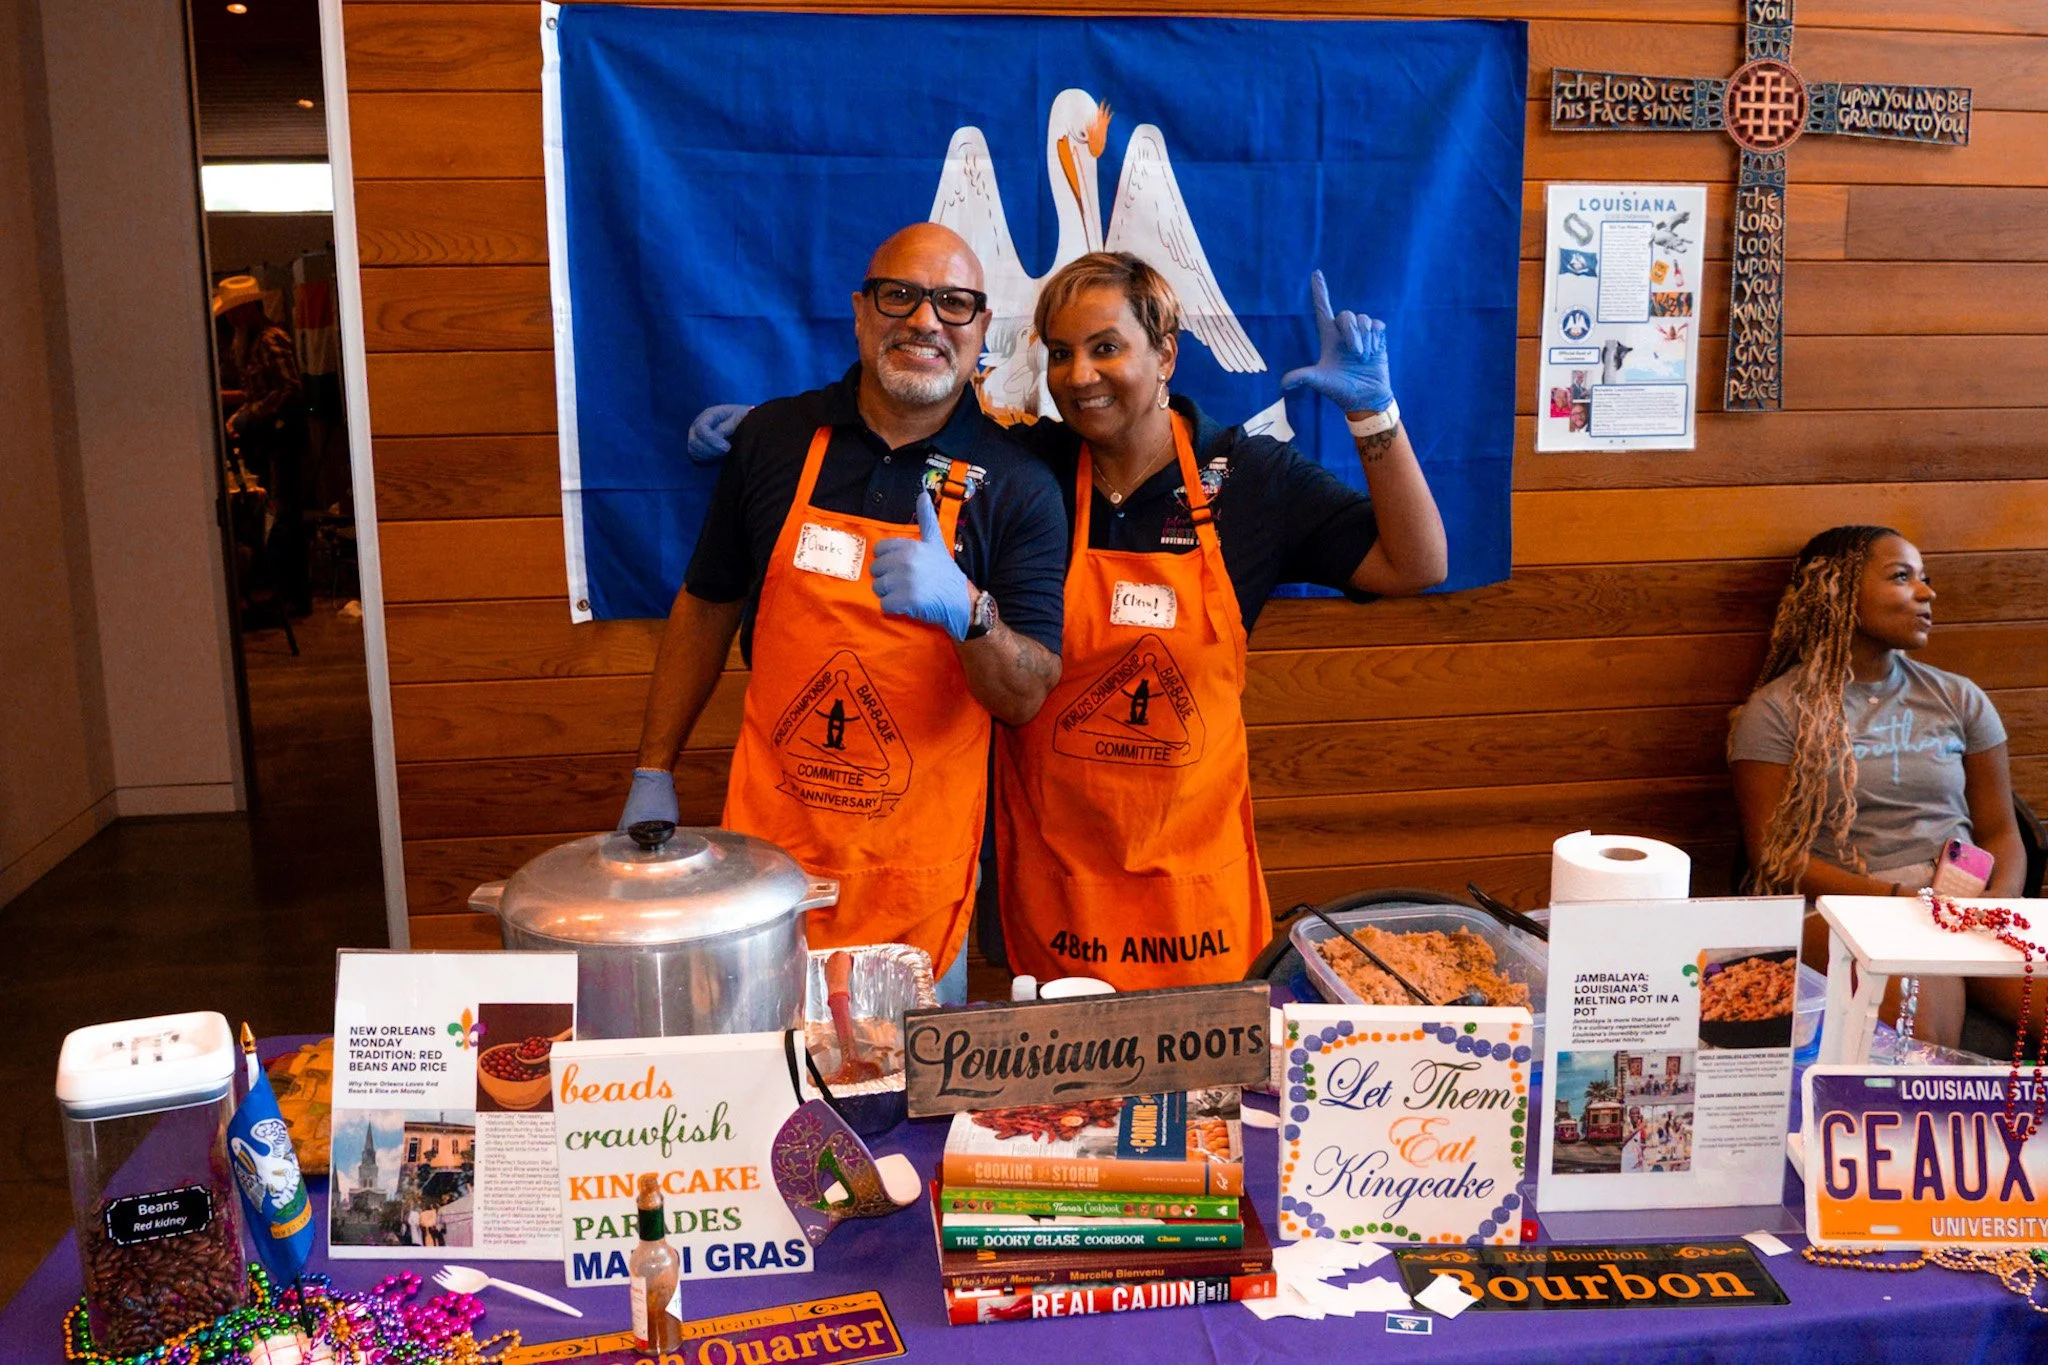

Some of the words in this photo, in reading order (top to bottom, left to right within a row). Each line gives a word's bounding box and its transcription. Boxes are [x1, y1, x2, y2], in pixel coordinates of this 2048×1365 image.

[1579, 198, 1677, 212] LOUISIANA
[790, 671, 832, 722] CHAMPIONSHIP
[1060, 697, 1093, 732] WORLD'S
[1090, 653, 1140, 706] CHAMPIONSHIP
[1160, 666, 1195, 721] BAR-B-QUE
[856, 684, 896, 745] BAR-B-QUE
[1096, 741, 1171, 761] COMMITTEE
[797, 763, 865, 787] COMMITTEE
[800, 788, 878, 808] ANNIVERSARY
[1050, 930, 1107, 962] 48th
[1121, 929, 1230, 964] ANNUAL
[1575, 973, 1649, 983] JAMBALAYA:
[1575, 984, 1649, 994] LOUISIANA'S
[1574, 995, 1626, 1005] MELTING
[1630, 995, 1653, 1004] POT
[1656, 995, 1668, 1003] IN
[1671, 994, 1680, 1003] A
[1574, 1007, 1597, 1016] POT
[350, 1026, 377, 1036] NEW
[381, 1026, 436, 1036] ORLEANS
[349, 1038, 402, 1048] MONDAY
[349, 1050, 416, 1060] TRADITION:
[419, 1050, 443, 1060] RED
[909, 1026, 1145, 1097] Louisiana
[1156, 1024, 1265, 1064] ROOTS
[349, 1062, 388, 1072] BEANS
[391, 1062, 417, 1072] AND
[420, 1062, 447, 1072] RICE
[560, 1063, 674, 1105] beads
[1319, 1057, 1393, 1111] Let
[1403, 1058, 1516, 1110] Them
[1901, 1080, 2004, 1101] LOUISIANA
[565, 1101, 737, 1158] crawfish
[1388, 1116, 1476, 1168] Eat
[1821, 1111, 2035, 1202] GEAUX
[974, 1163, 1033, 1181] COOKING
[1052, 1164, 1100, 1183] STORM
[1306, 1145, 1495, 1219] Kingcake
[137, 1200, 180, 1216] Beans
[1084, 1202, 1120, 1215] Cookbook
[133, 1221, 153, 1233] Red
[155, 1215, 188, 1231] kidney
[573, 1206, 742, 1241] PARDES
[1932, 1217, 2048, 1238] UNIVERSITY
[956, 1236, 978, 1245] THE
[984, 1234, 1031, 1246] DOOKY
[1033, 1234, 1080, 1246] CHASE
[1084, 1235, 1145, 1245] COOKBOOK
[573, 1246, 692, 1282] MAI
[705, 1238, 806, 1272] GRAS
[1504, 1251, 1548, 1263] Rue
[1551, 1249, 1648, 1263] Bourbon
[983, 1274, 1006, 1286] Your
[1070, 1270, 1113, 1281] Marcelle
[1116, 1268, 1165, 1279] Bienvenu
[1032, 1289, 1100, 1319] REAL
[1112, 1280, 1195, 1312] CAJUN
[698, 1318, 885, 1365] Quarter
